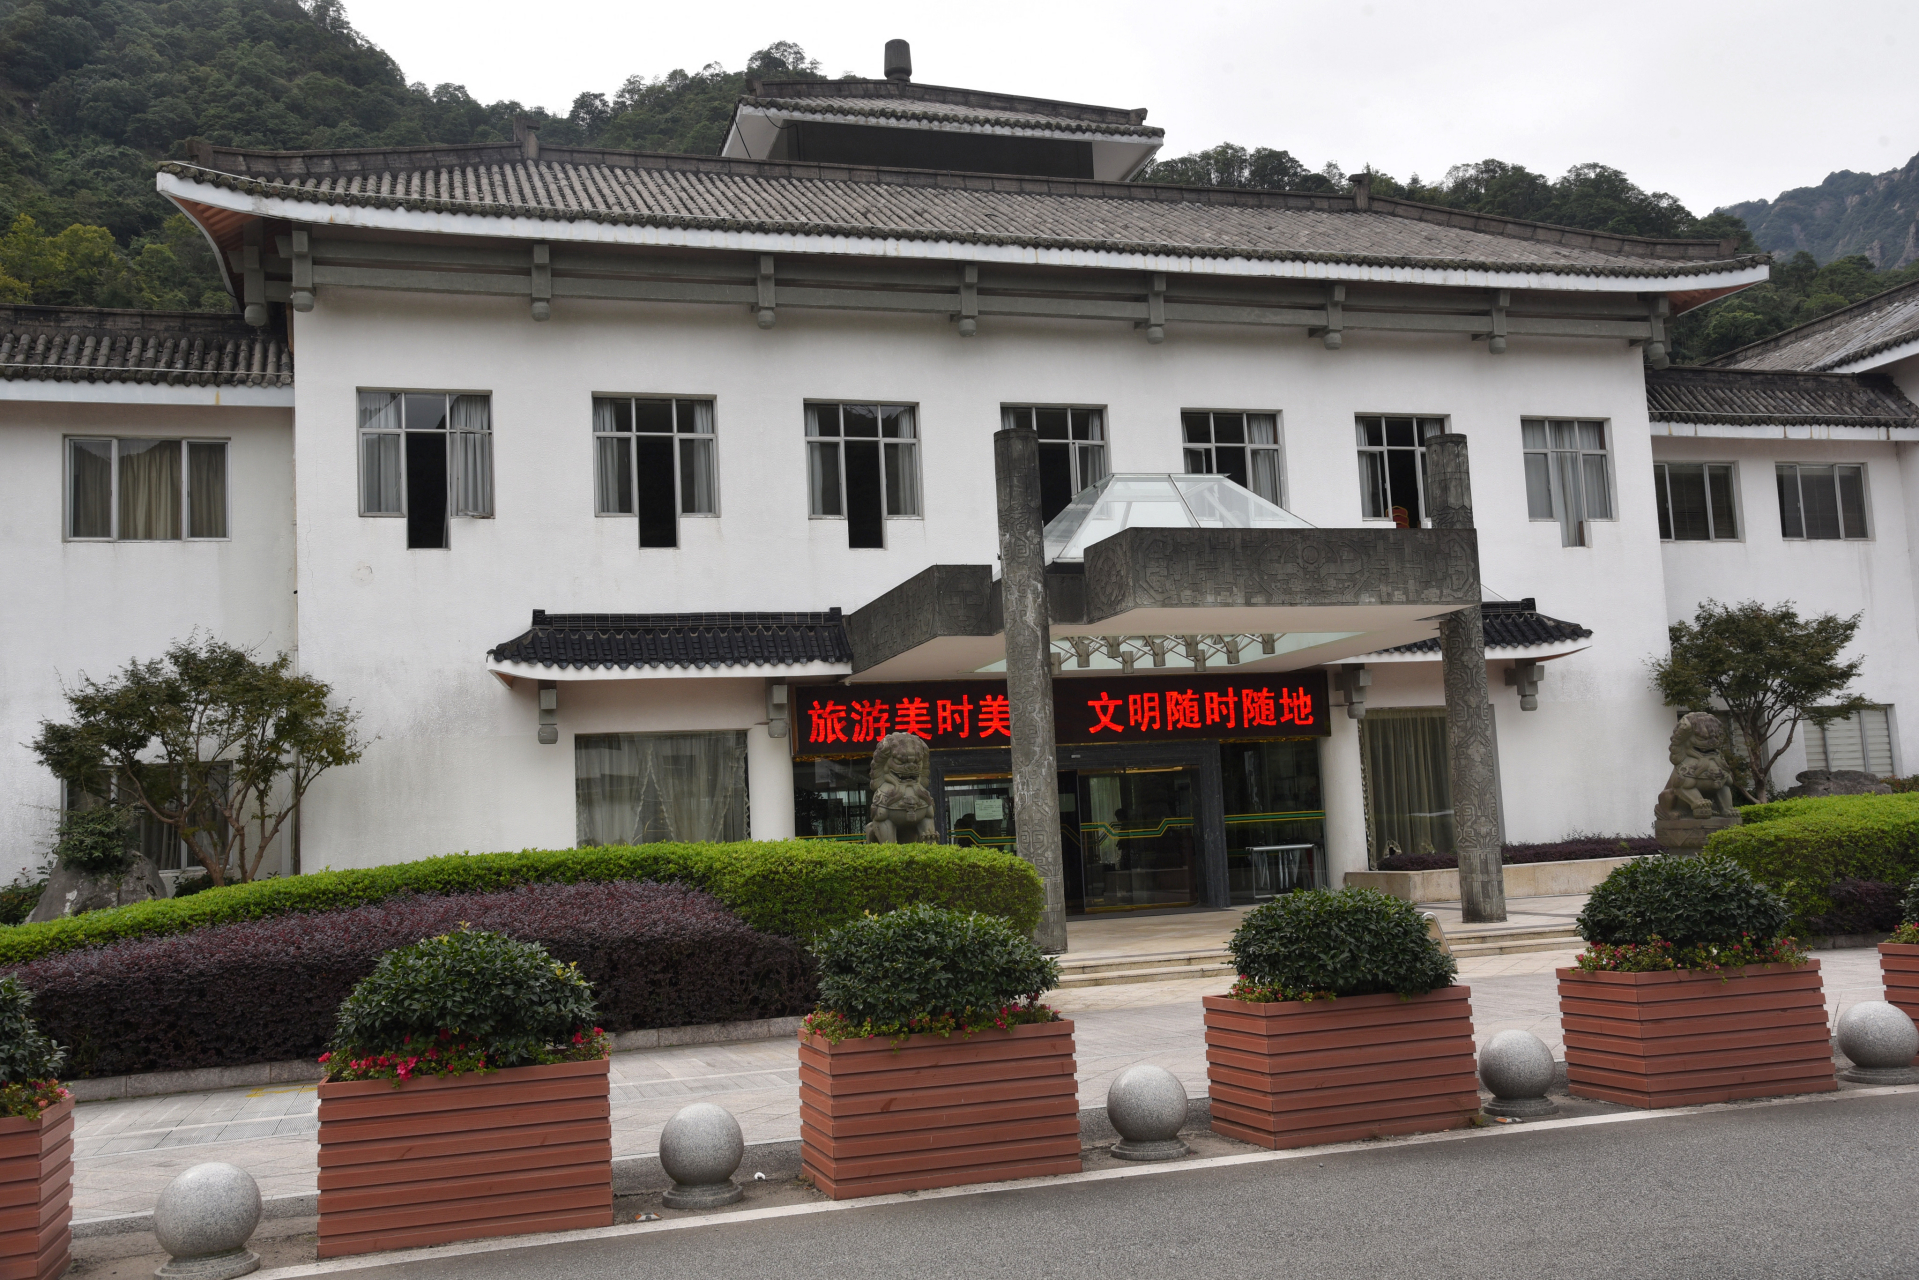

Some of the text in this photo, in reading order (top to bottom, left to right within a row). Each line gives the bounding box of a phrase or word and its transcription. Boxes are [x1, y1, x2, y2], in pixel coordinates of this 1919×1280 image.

[1087, 686, 1314, 734] 文明随时随地
